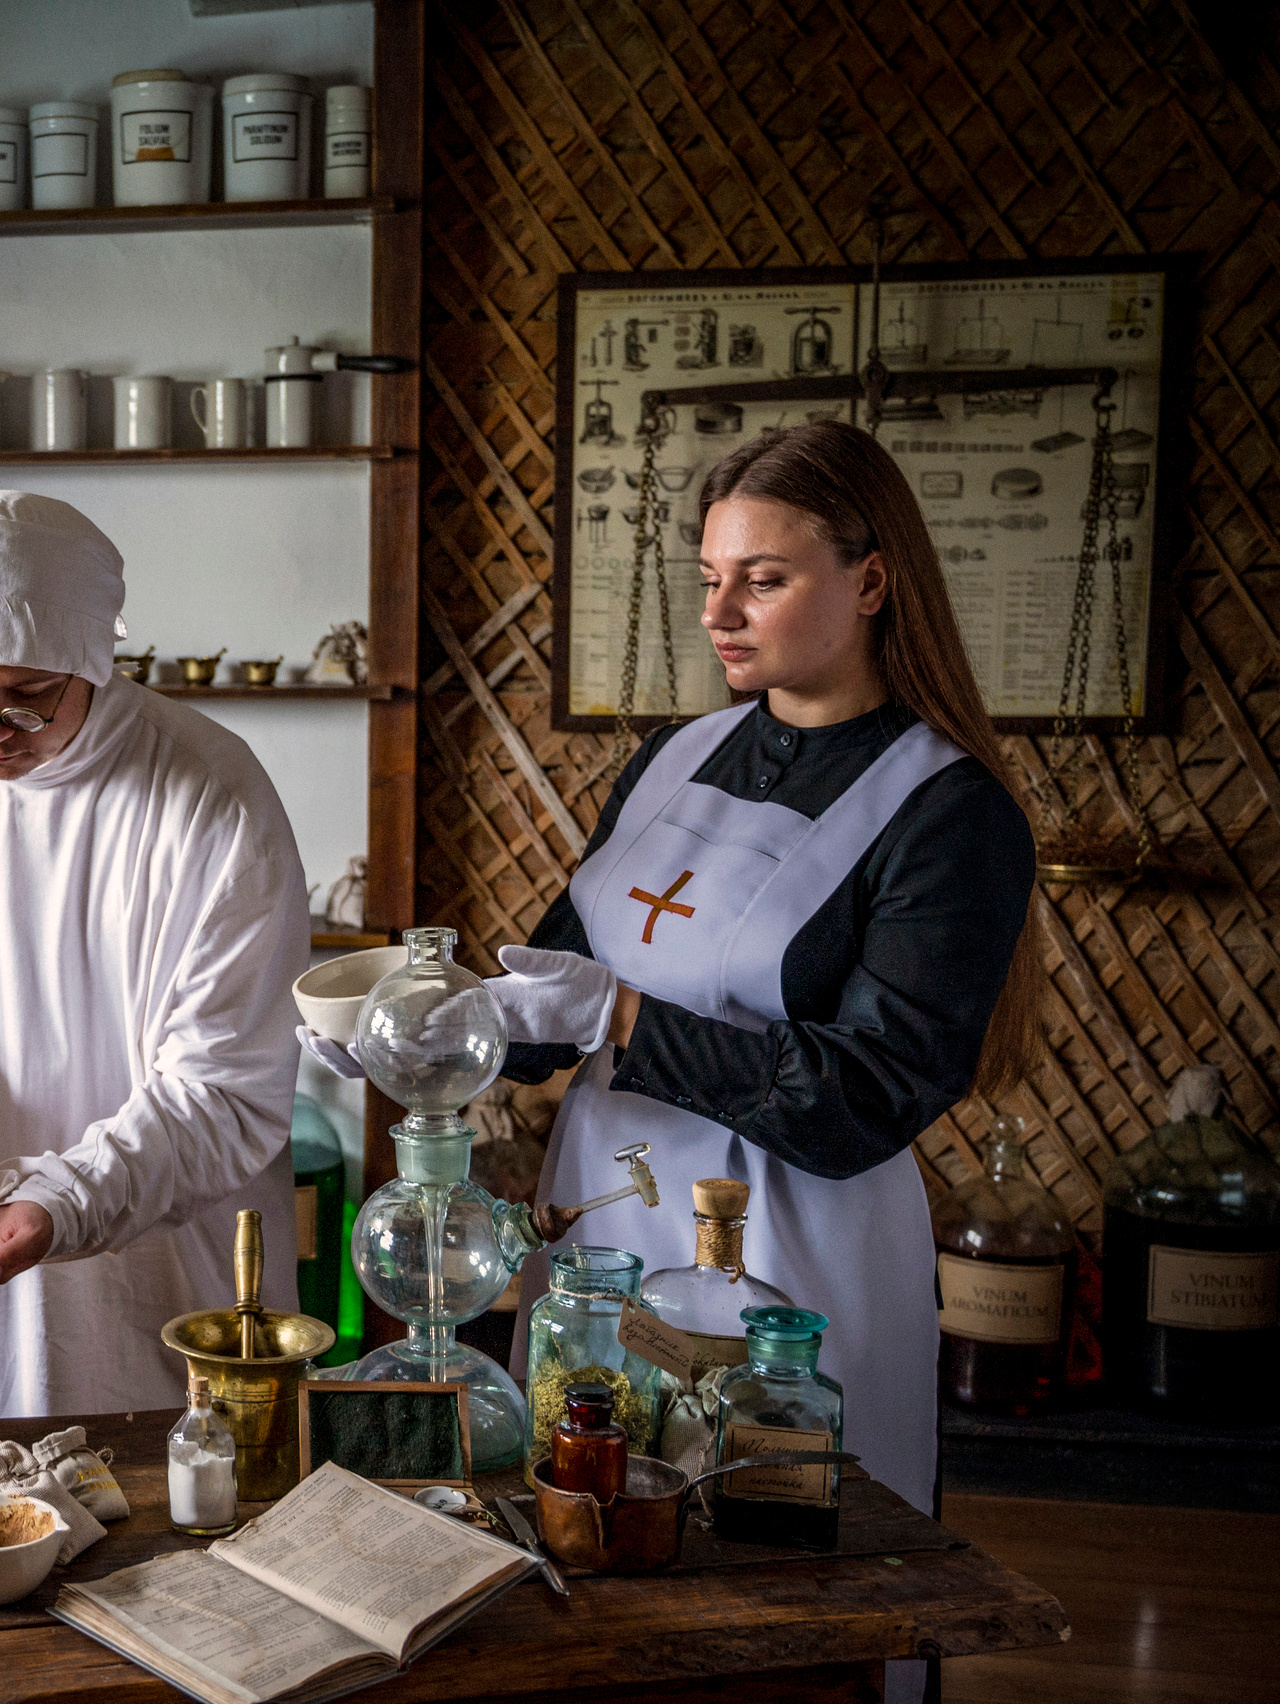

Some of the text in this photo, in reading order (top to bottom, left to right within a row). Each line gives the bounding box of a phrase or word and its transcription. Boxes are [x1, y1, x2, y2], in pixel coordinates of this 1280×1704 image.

[1189, 1272, 1255, 1290] VINUM
[972, 1286, 1028, 1304] VINUM
[950, 1296, 1049, 1318] AROMATICUM
[749, 1473, 804, 1490] настойка
